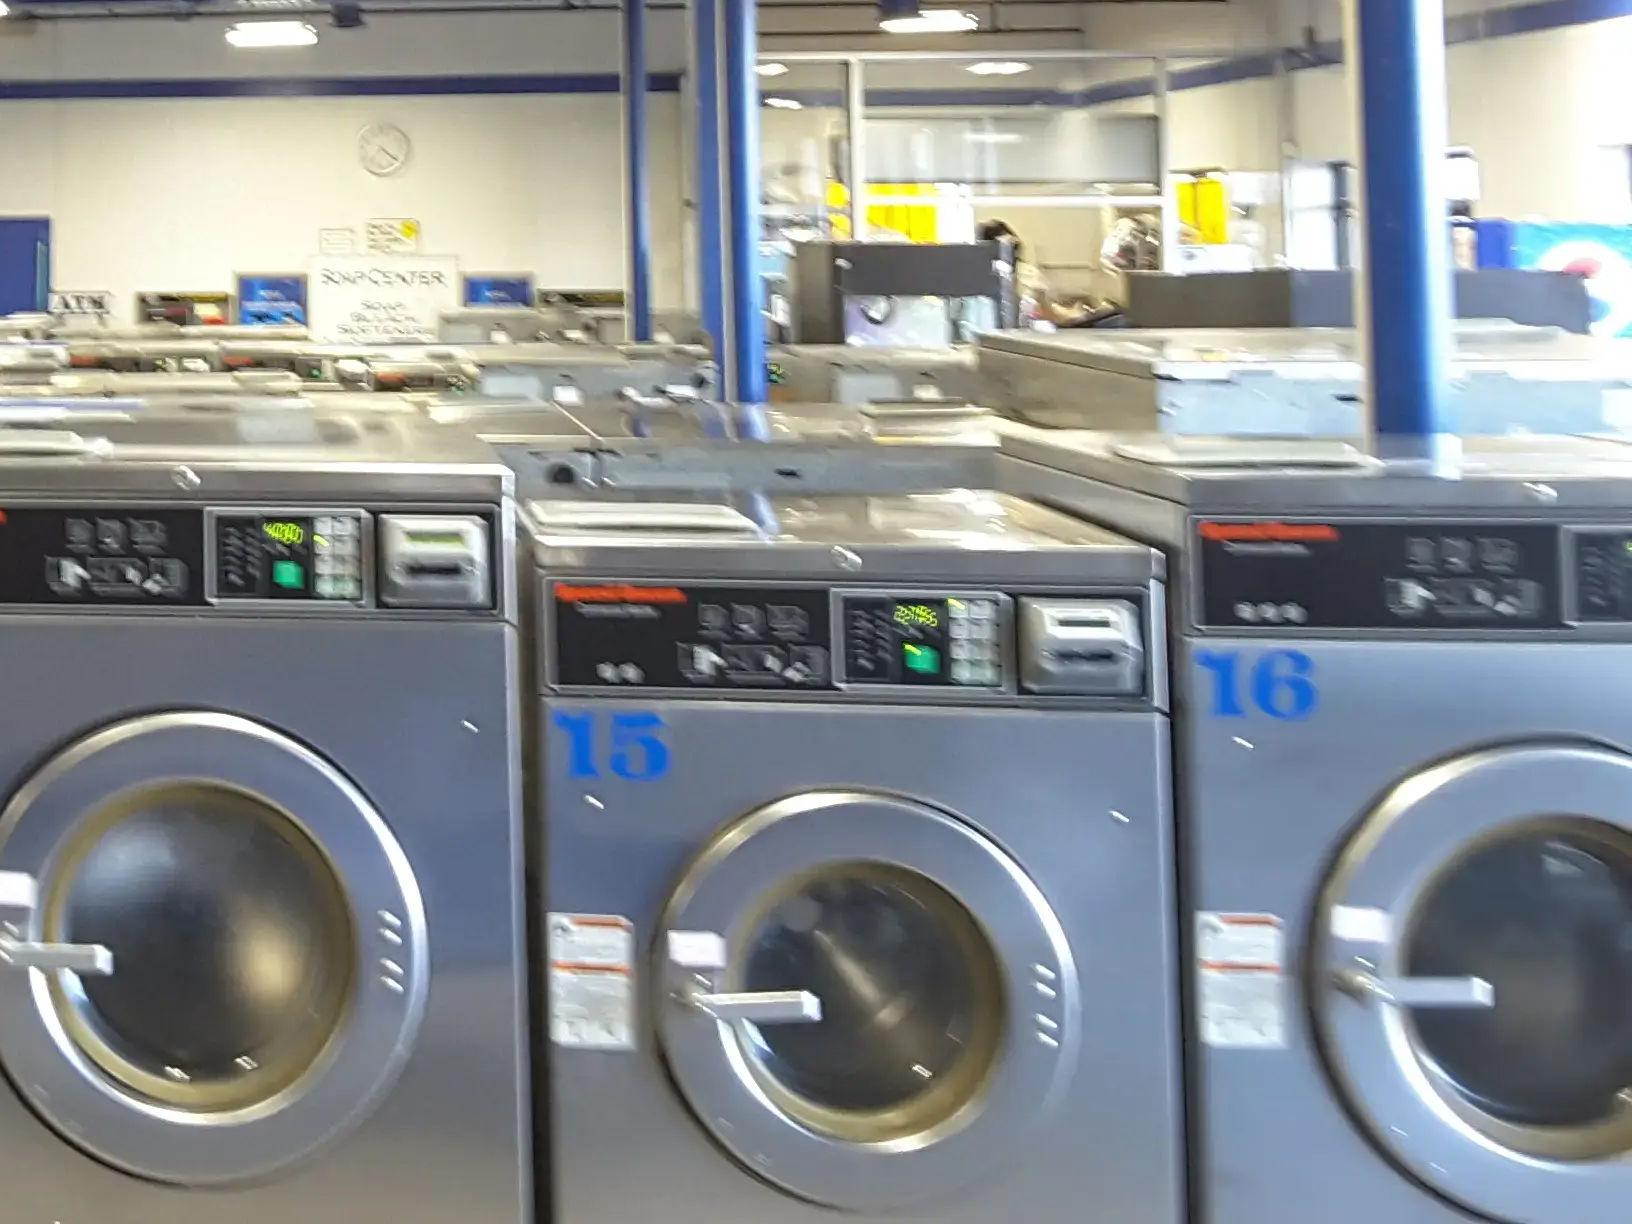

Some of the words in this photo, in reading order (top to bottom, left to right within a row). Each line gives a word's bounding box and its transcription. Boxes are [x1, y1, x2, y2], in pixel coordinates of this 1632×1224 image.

[368, 268, 448, 287] CENTER
[53, 294, 106, 313] ATM
[1193, 649, 1318, 720] 16
[552, 711, 673, 782] 15
